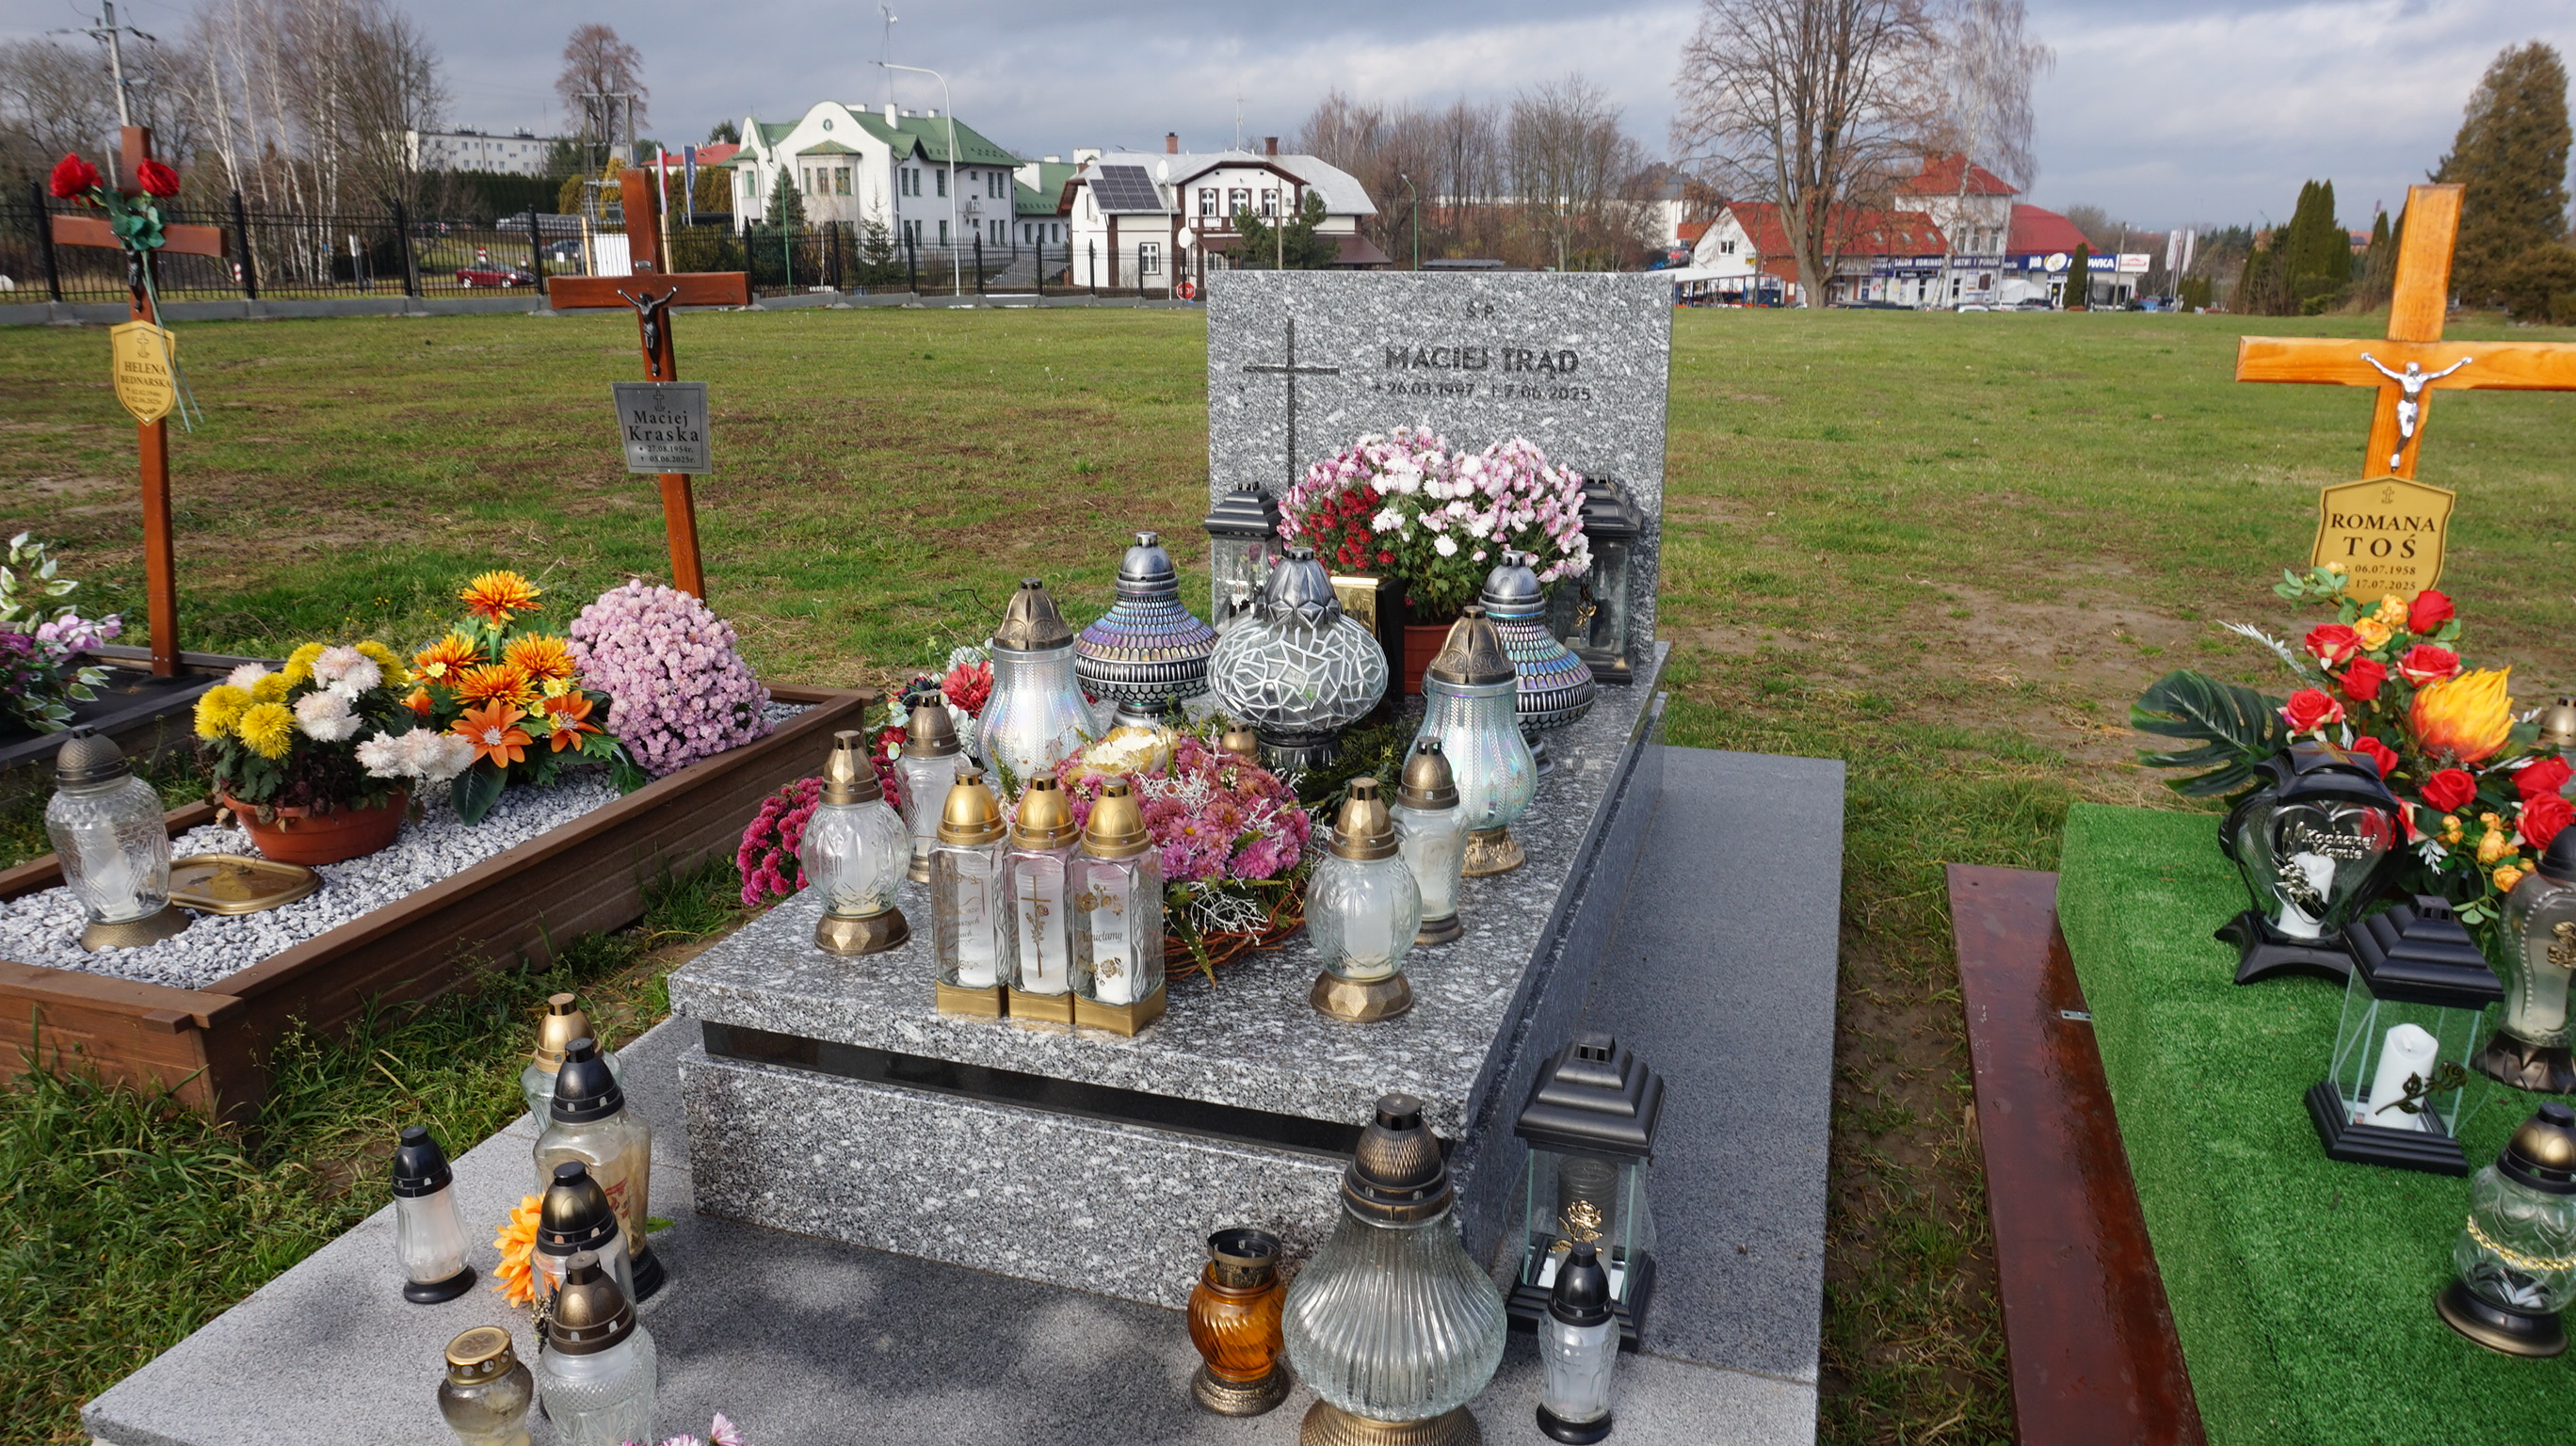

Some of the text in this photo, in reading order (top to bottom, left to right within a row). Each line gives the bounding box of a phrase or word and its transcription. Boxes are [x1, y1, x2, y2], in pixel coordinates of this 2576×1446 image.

[1894, 258, 1912, 267] SALON
[1916, 257, 1945, 267] KOMINKÓ
[1954, 258, 1972, 267] DRZWI
[1385, 345, 1489, 370] MACIEJ
[124, 362, 167, 376] HELENA
[120, 375, 172, 388] BEDNARSKA
[634, 410, 688, 428] Maciej
[628, 426, 700, 442] Kraska
[2330, 513, 2436, 533] ROMANA
[2343, 534, 2416, 559] TOŚ
[2355, 564, 2416, 575] 06.07.1958
[2356, 579, 2416, 590] 17.07.2025
[2301, 828, 2377, 850] Kochanej
[2311, 843, 2363, 860] Mamie
